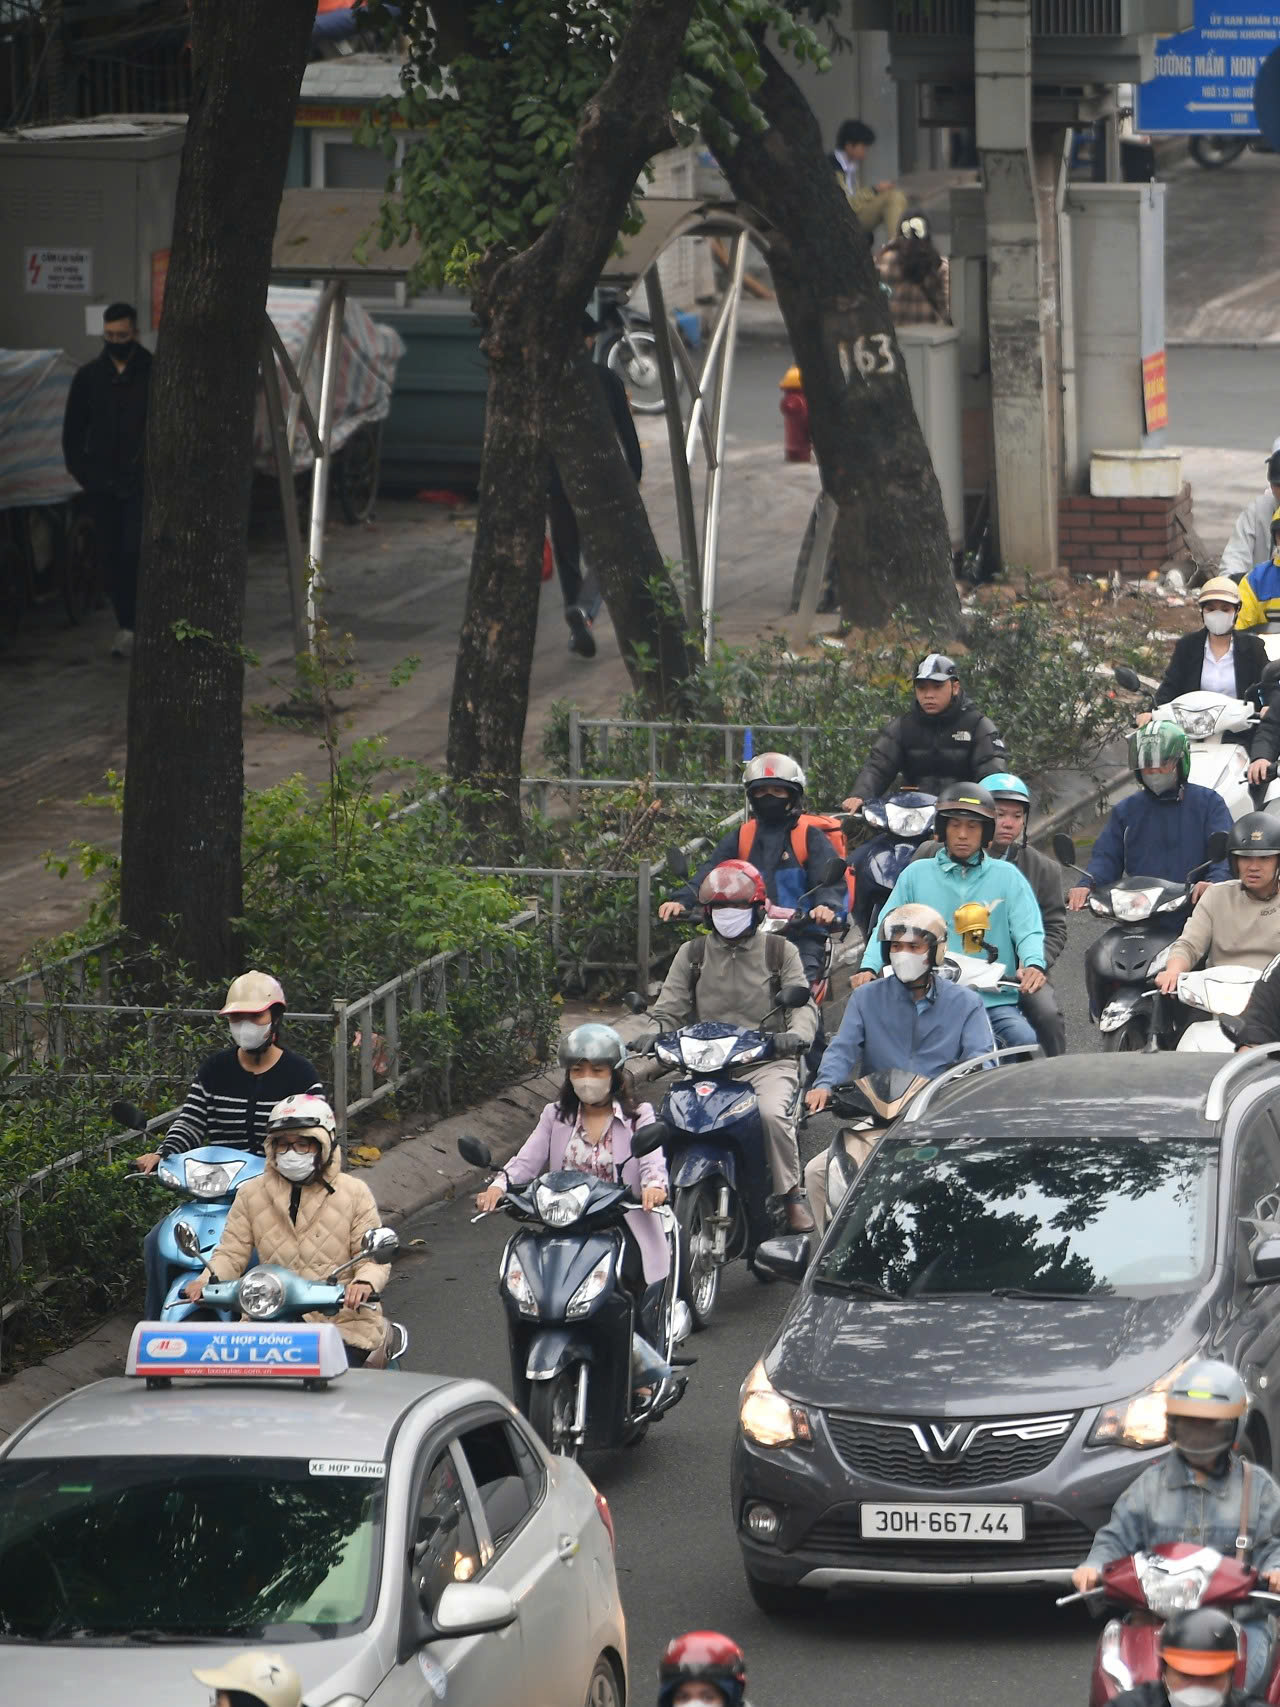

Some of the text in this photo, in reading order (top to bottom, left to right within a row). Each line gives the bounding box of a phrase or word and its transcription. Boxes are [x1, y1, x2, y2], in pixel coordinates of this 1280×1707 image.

[1153, 50, 1192, 77] RƯỜNG
[1231, 56, 1257, 77] NON
[838, 333, 895, 384] 163
[212, 1332, 293, 1347] XE HỢP ĐỒNG
[200, 1344, 240, 1362] ÂU
[249, 1347, 302, 1366] LẠC
[311, 1463, 324, 1472] XE
[328, 1463, 350, 1475] HỢP
[876, 1510, 1009, 1534] 30H-667.44
